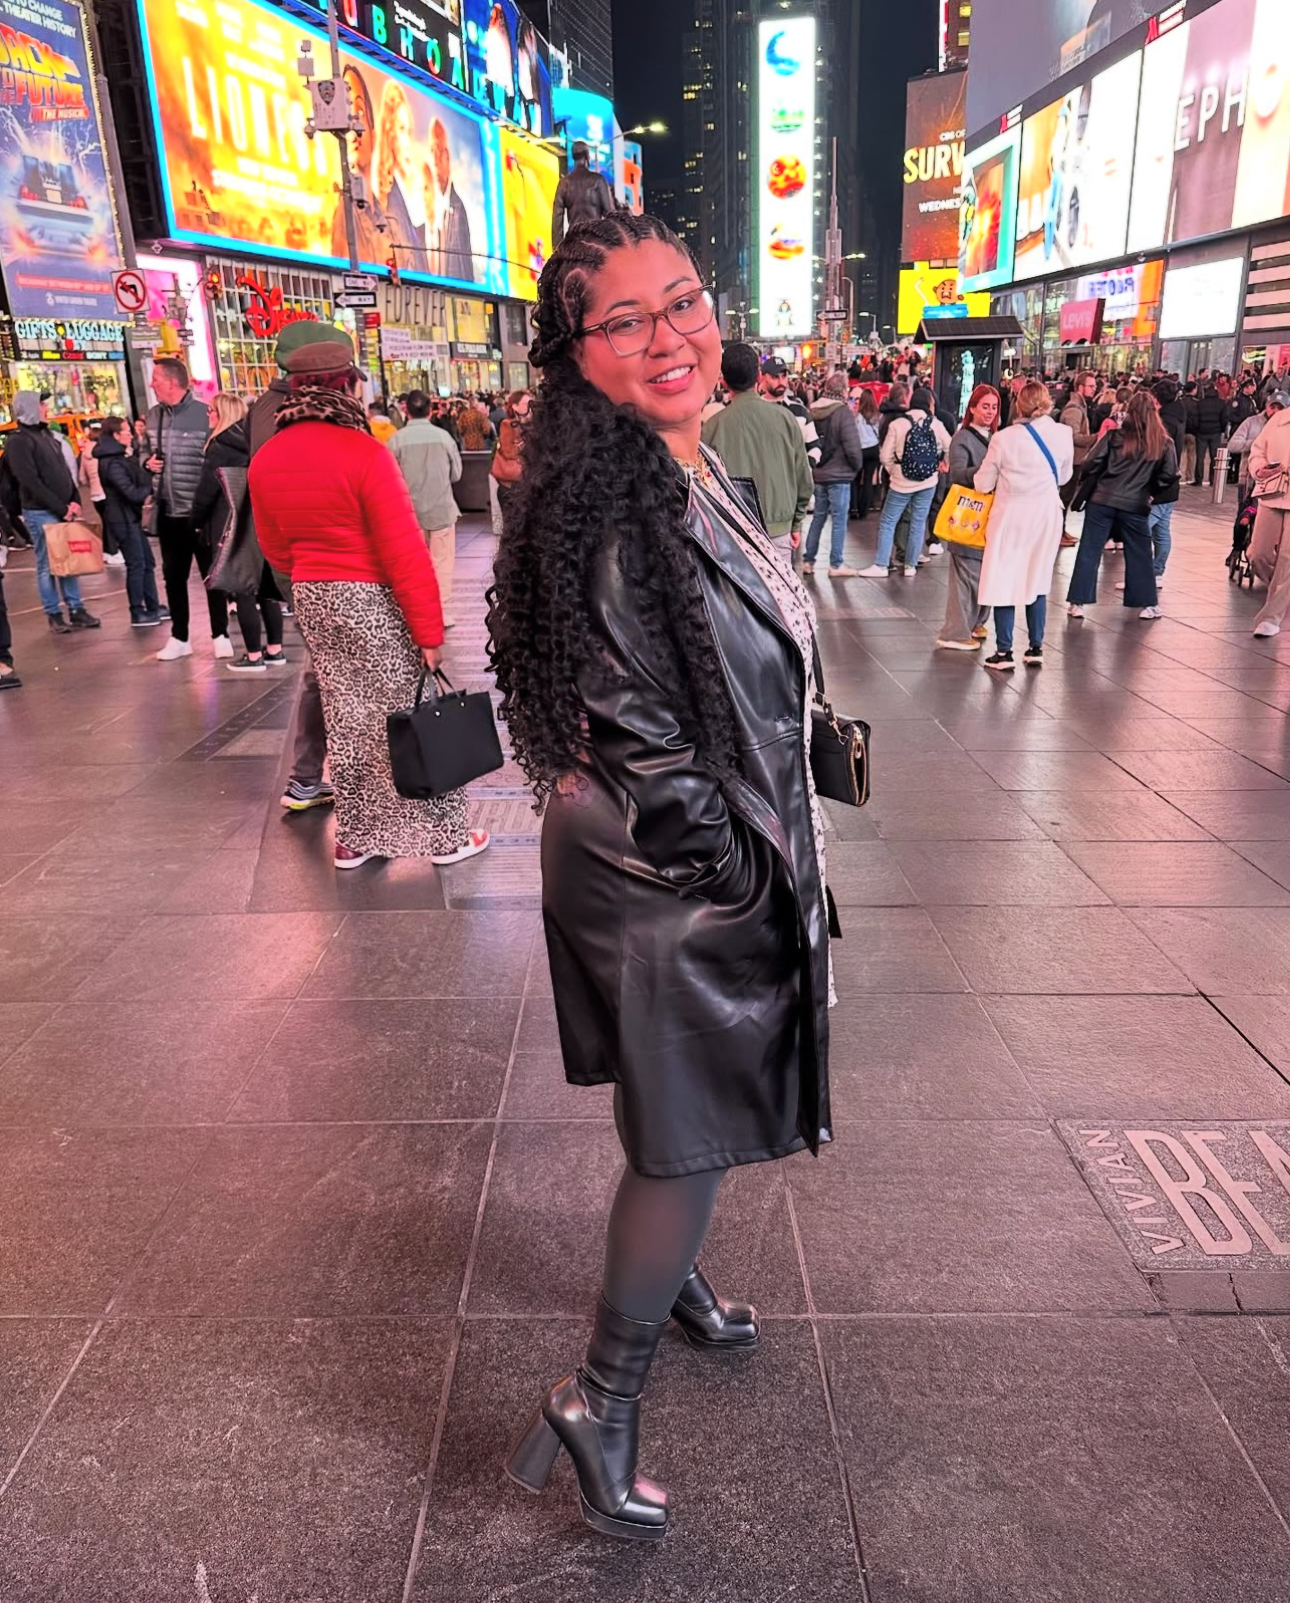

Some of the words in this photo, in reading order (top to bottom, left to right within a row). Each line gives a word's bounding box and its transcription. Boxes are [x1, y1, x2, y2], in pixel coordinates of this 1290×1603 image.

[28, 0, 63, 21] CHANGE
[15, 69, 85, 107] FUTURE
[384, 281, 447, 327] FOREVER
[15, 321, 57, 339] GIFTS
[64, 322, 124, 341] LUGGAGE
[1078, 1129, 1187, 1255] VIVIAN
